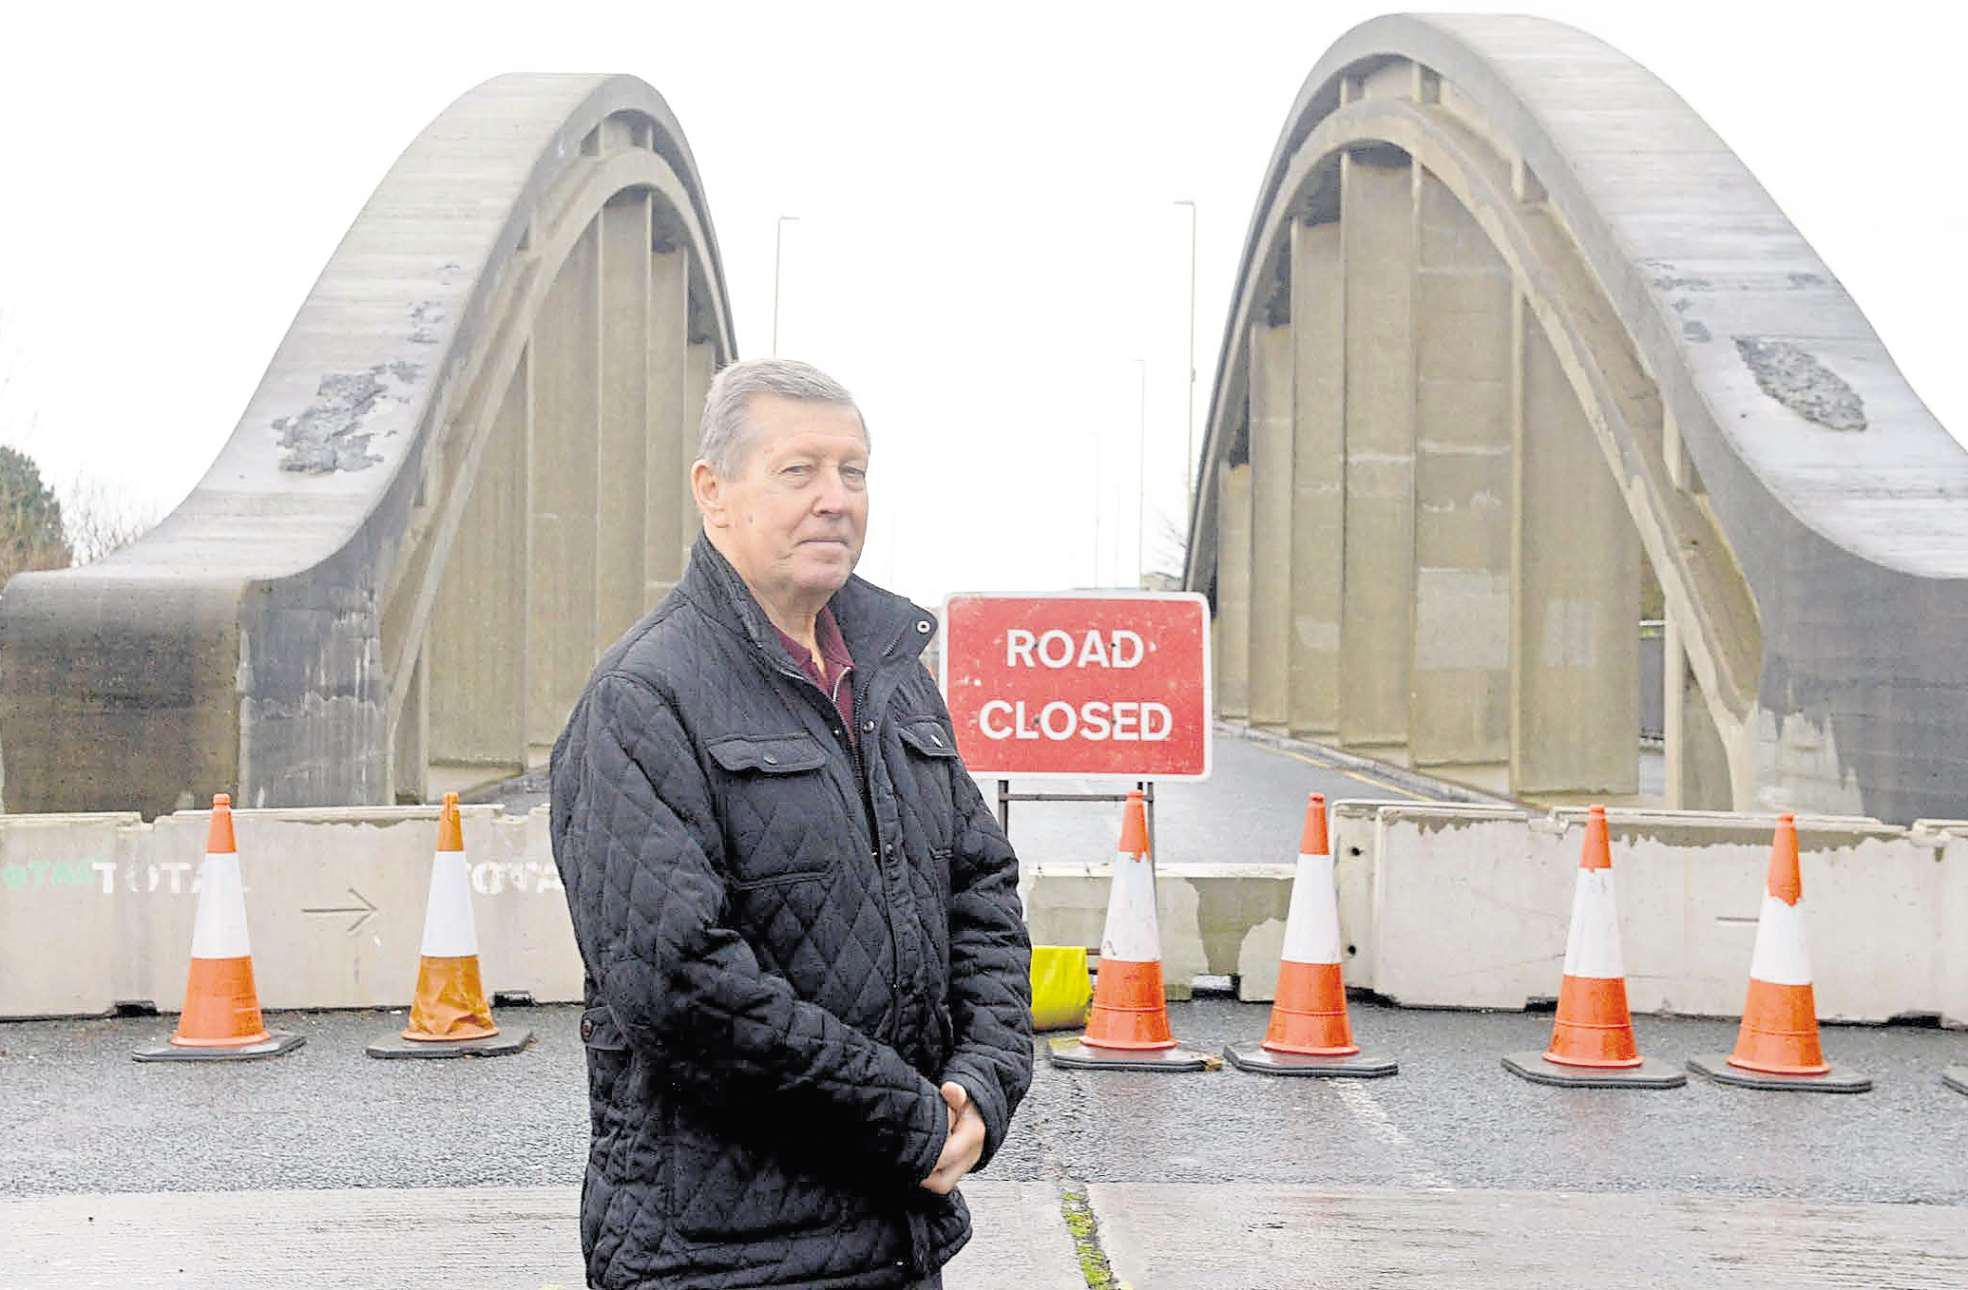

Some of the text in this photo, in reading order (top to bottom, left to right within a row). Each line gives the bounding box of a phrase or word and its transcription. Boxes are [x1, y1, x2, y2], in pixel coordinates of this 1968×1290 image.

[1006, 629, 1144, 668] ROAD
[979, 700, 1173, 741] CLOSED
[91, 861, 251, 894] TOT
[465, 861, 566, 895] OTA
